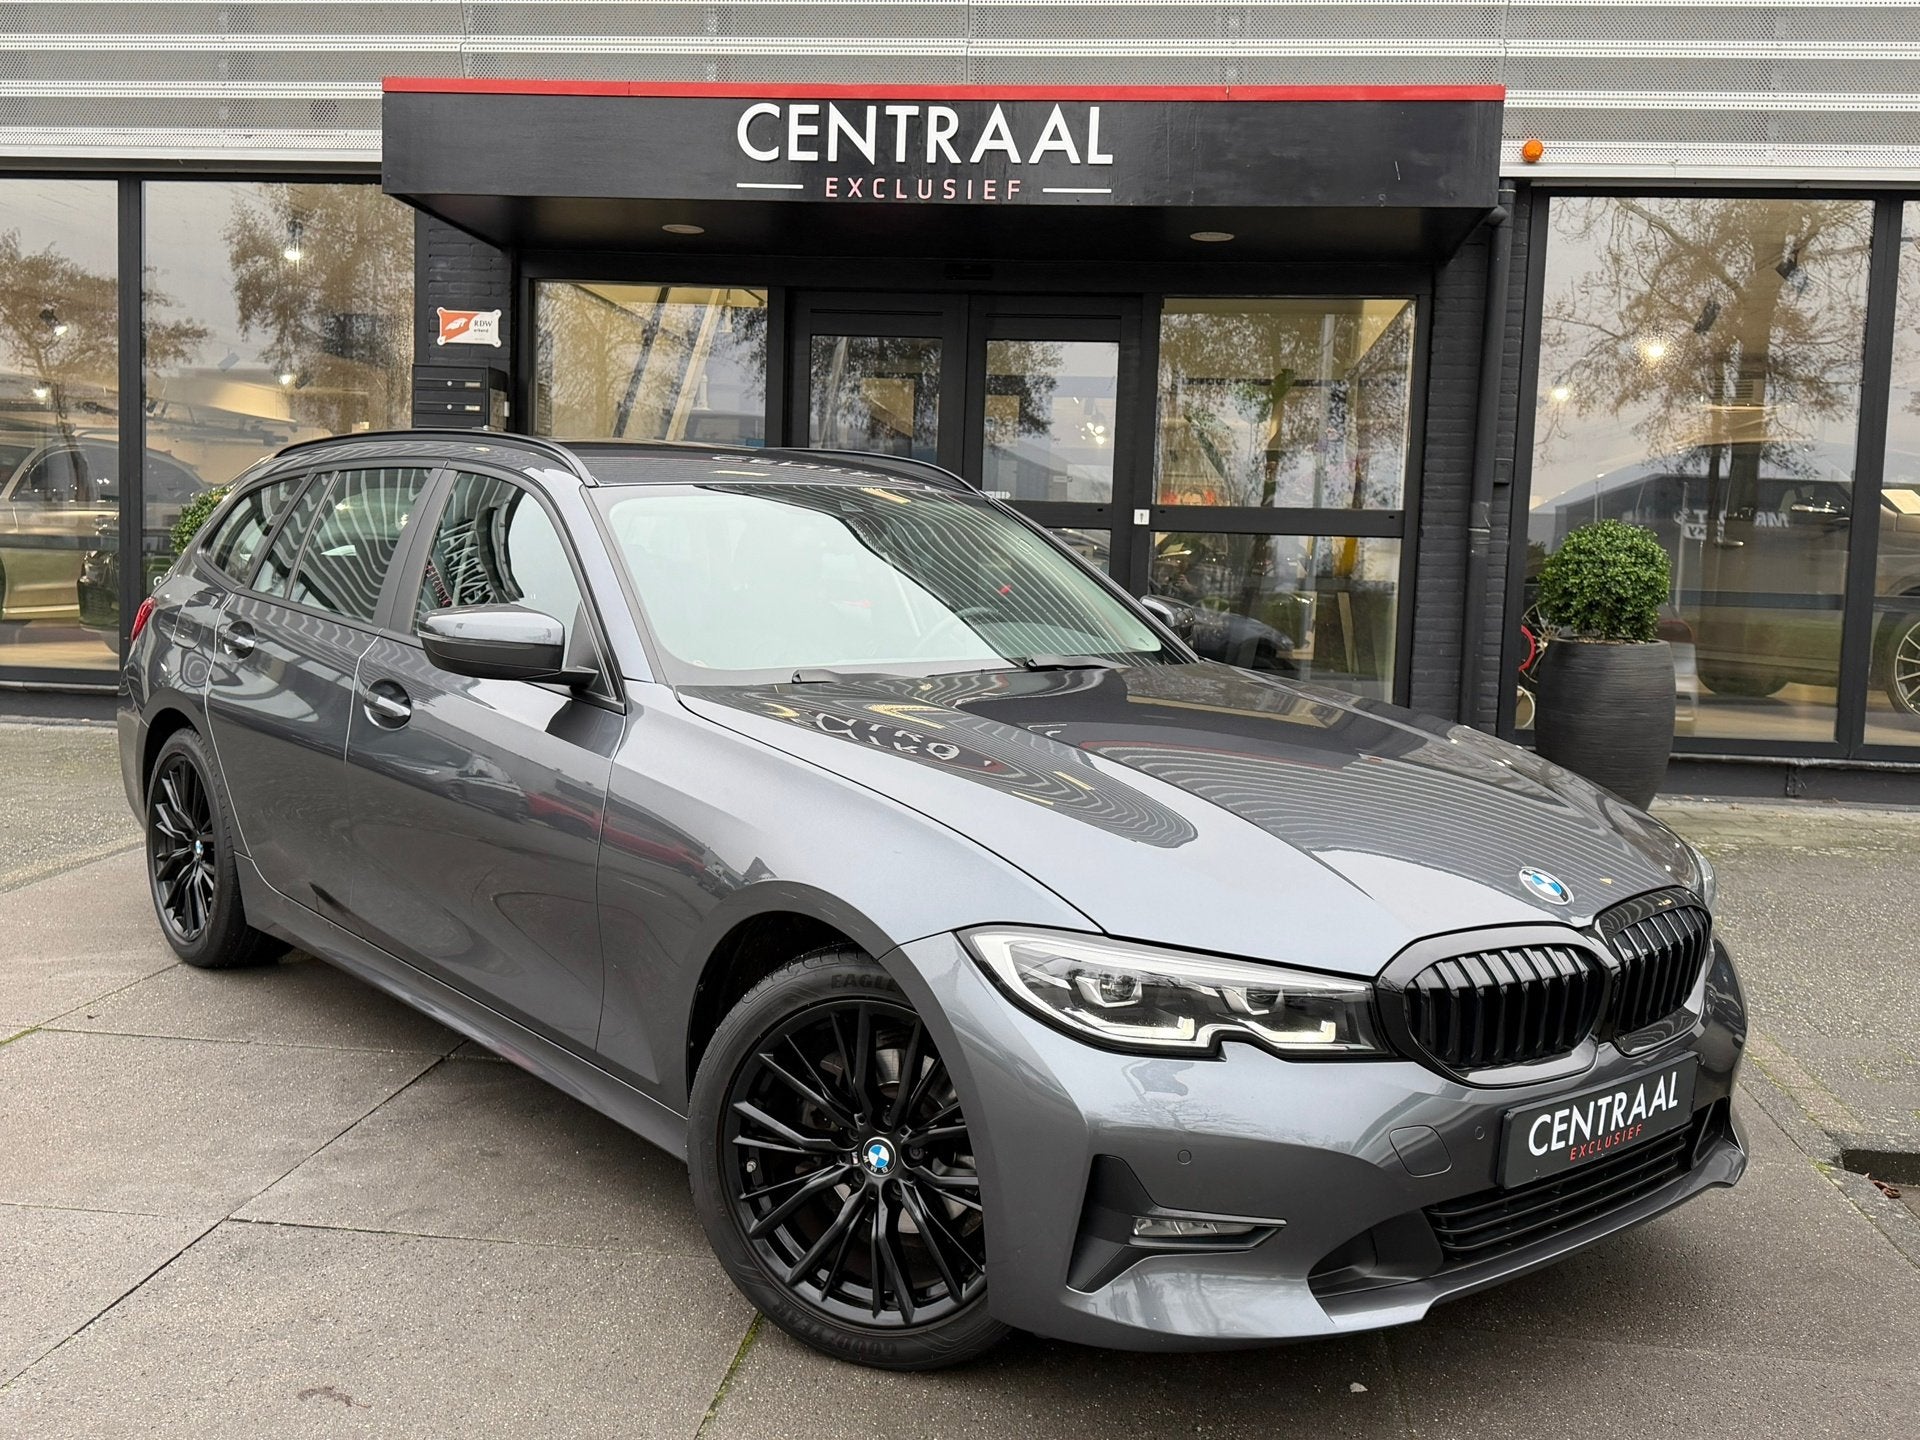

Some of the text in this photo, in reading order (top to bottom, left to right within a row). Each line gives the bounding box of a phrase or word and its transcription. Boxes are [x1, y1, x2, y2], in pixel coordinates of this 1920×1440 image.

[736, 101, 1114, 166] CENTRAAL
[824, 177, 1022, 200] EXCLUSIEF
[473, 319, 493, 327] RDW
[1528, 1071, 1679, 1157] CENTRAAL
[1569, 1123, 1643, 1161] EXCLUSIEF
